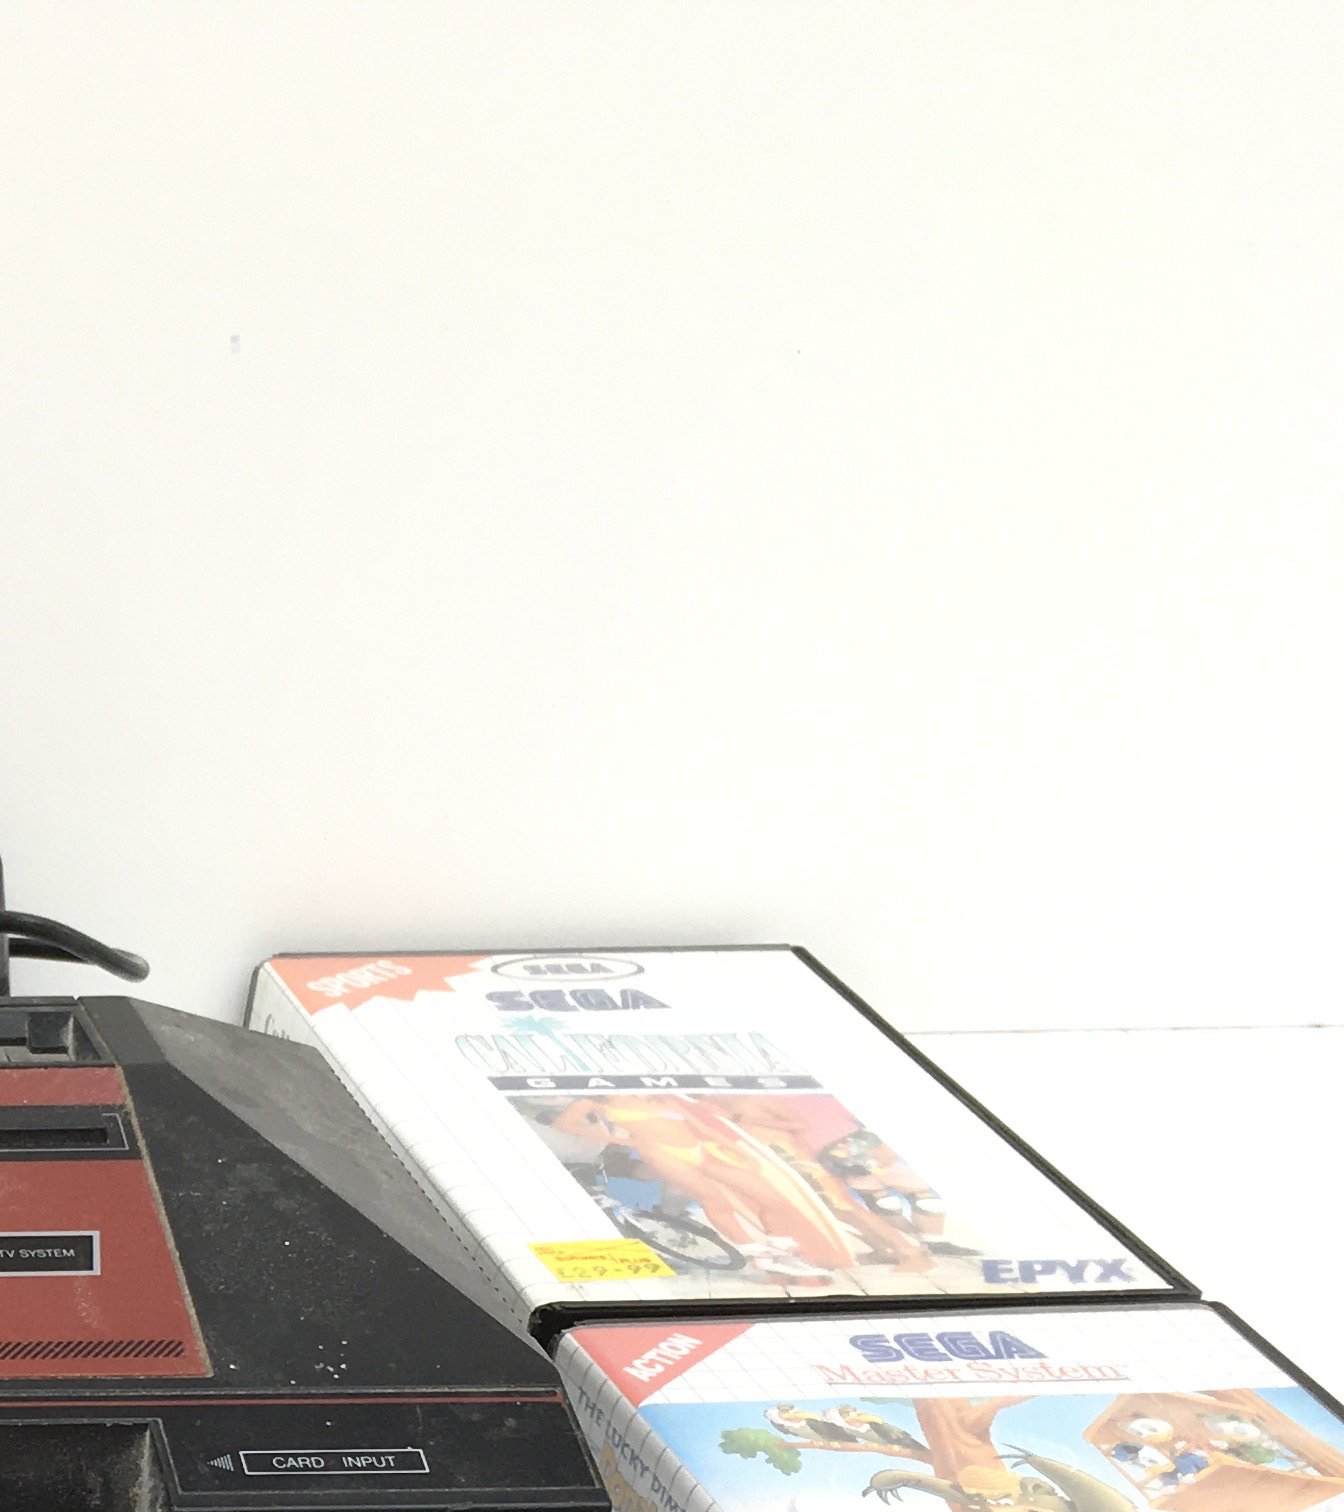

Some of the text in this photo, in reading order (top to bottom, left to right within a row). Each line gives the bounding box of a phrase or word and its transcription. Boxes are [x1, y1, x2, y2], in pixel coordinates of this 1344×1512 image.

[307, 960, 413, 997] SPORTS
[523, 962, 614, 976] SEGA
[485, 988, 672, 1011] SEGA
[526, 1076, 788, 1089] GAMES
[17, 1247, 76, 1259] SYSTEM
[980, 1259, 1138, 1284] EPYX
[623, 1333, 703, 1382] ACTION
[848, 1331, 1048, 1362] SEGA
[813, 1361, 1119, 1384] Master System
[578, 1386, 605, 1427] THE
[604, 1418, 650, 1478] LUCKY
[272, 1454, 397, 1470] CARD INPUT
